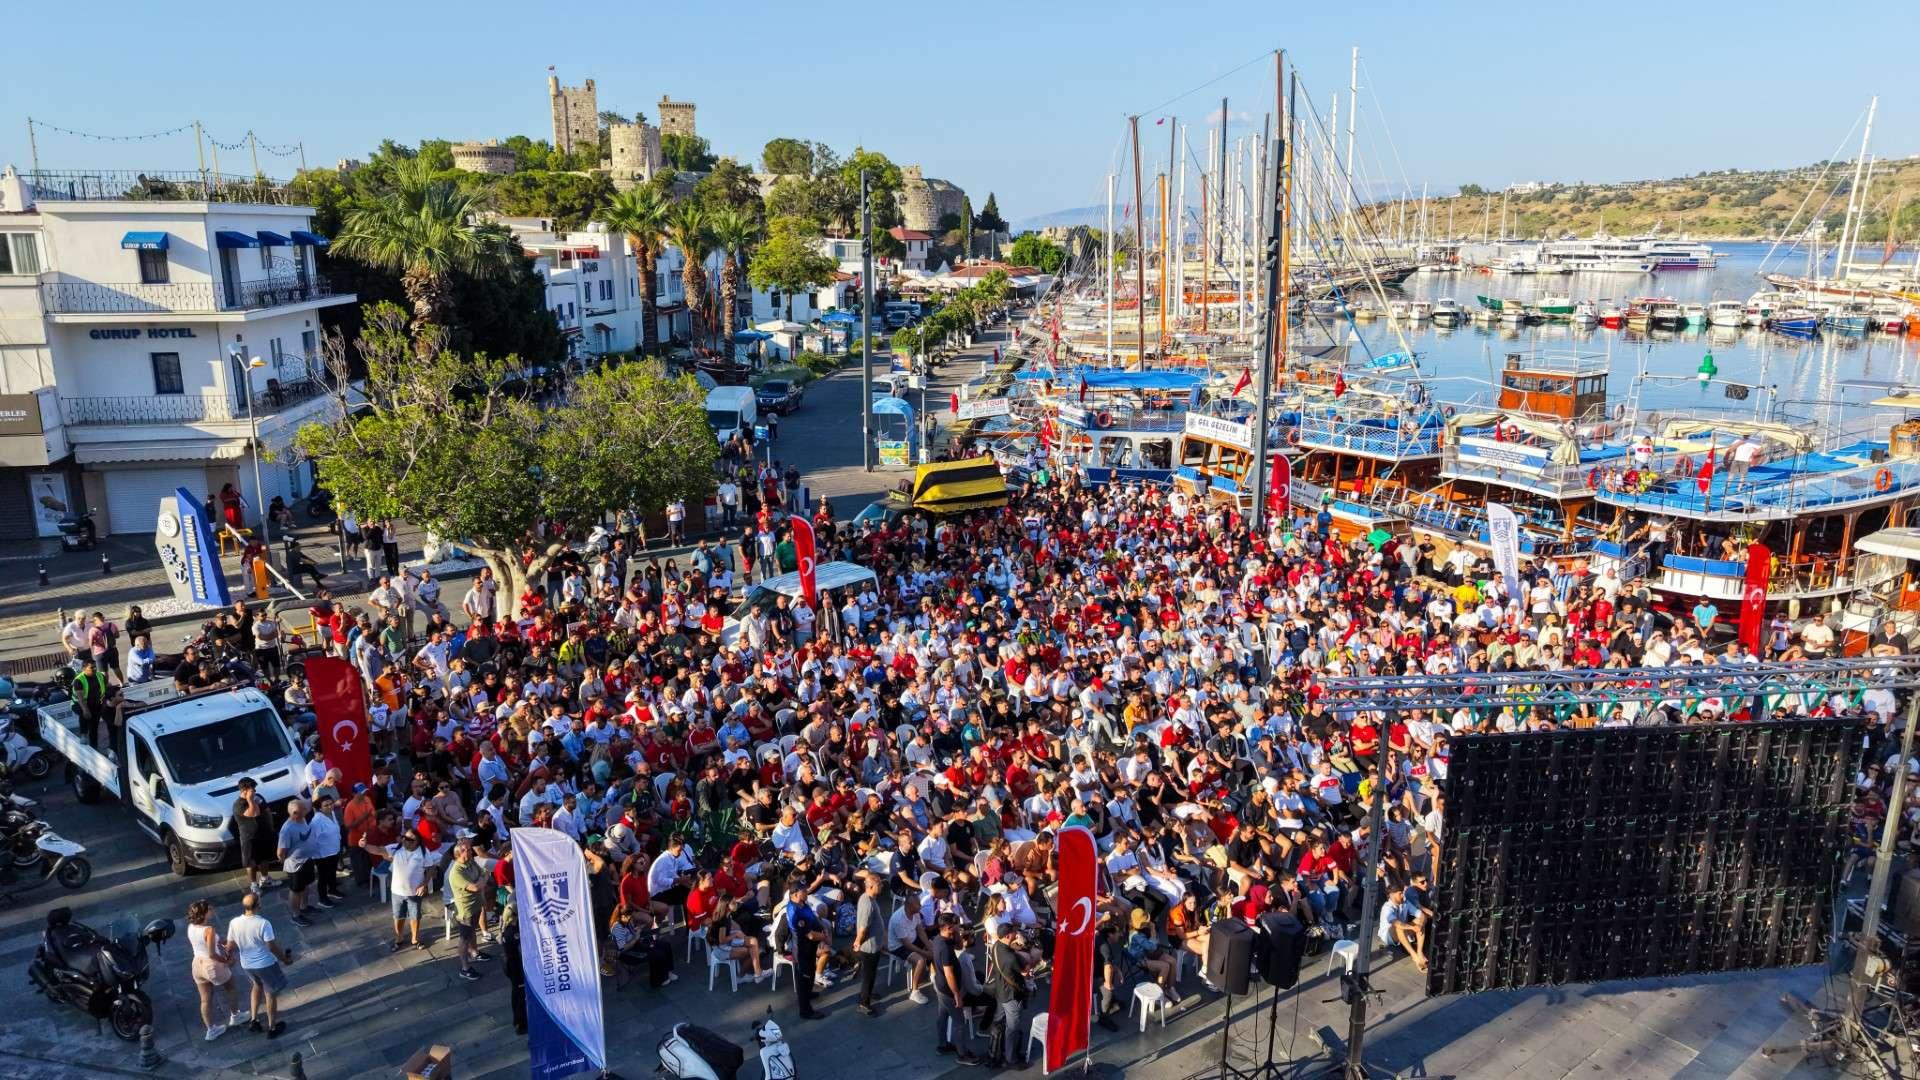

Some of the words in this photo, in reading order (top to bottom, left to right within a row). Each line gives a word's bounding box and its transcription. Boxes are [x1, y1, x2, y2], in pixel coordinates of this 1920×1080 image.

[89, 328, 142, 340] GURUP
[147, 327, 197, 339] HOTEL
[190, 553, 206, 600] BODRUM
